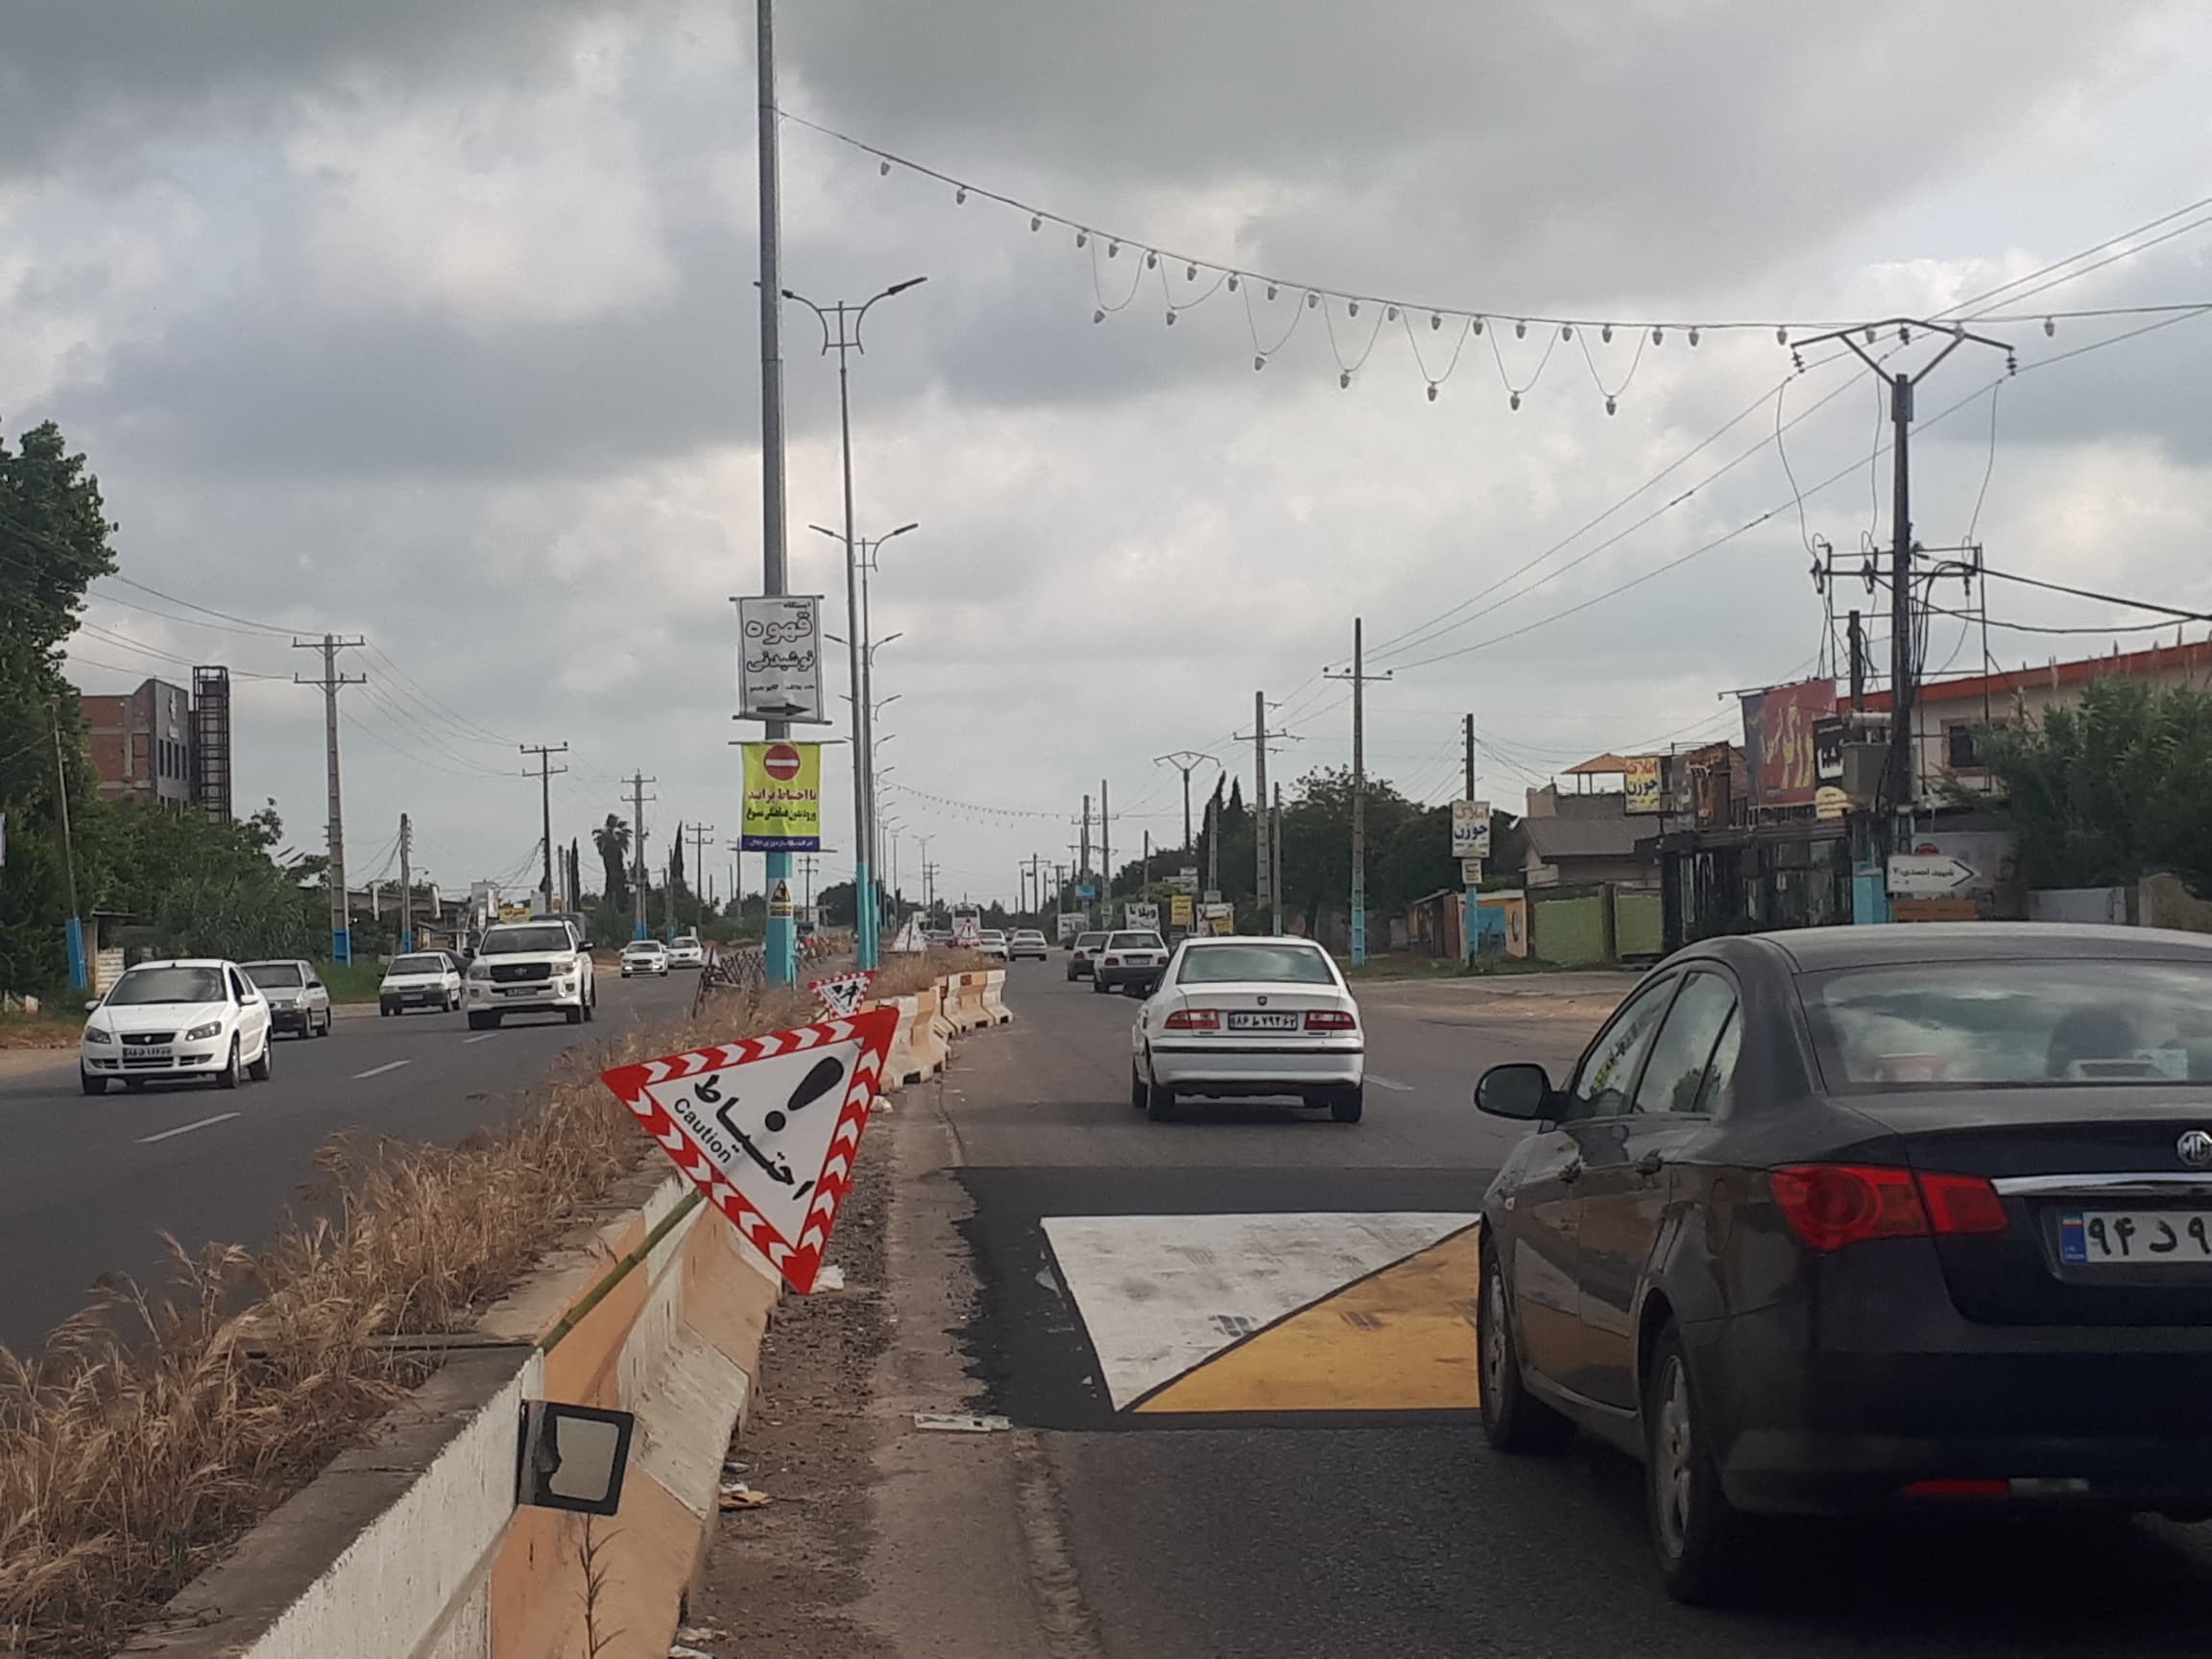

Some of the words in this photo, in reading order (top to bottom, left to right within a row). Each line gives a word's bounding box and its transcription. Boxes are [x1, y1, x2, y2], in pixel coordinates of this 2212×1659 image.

[745, 611, 813, 645] قهوه
[746, 650, 815, 672] نوشیدنی
[674, 1097, 732, 1164] Caution
[694, 1074, 815, 1201] احتیاط
